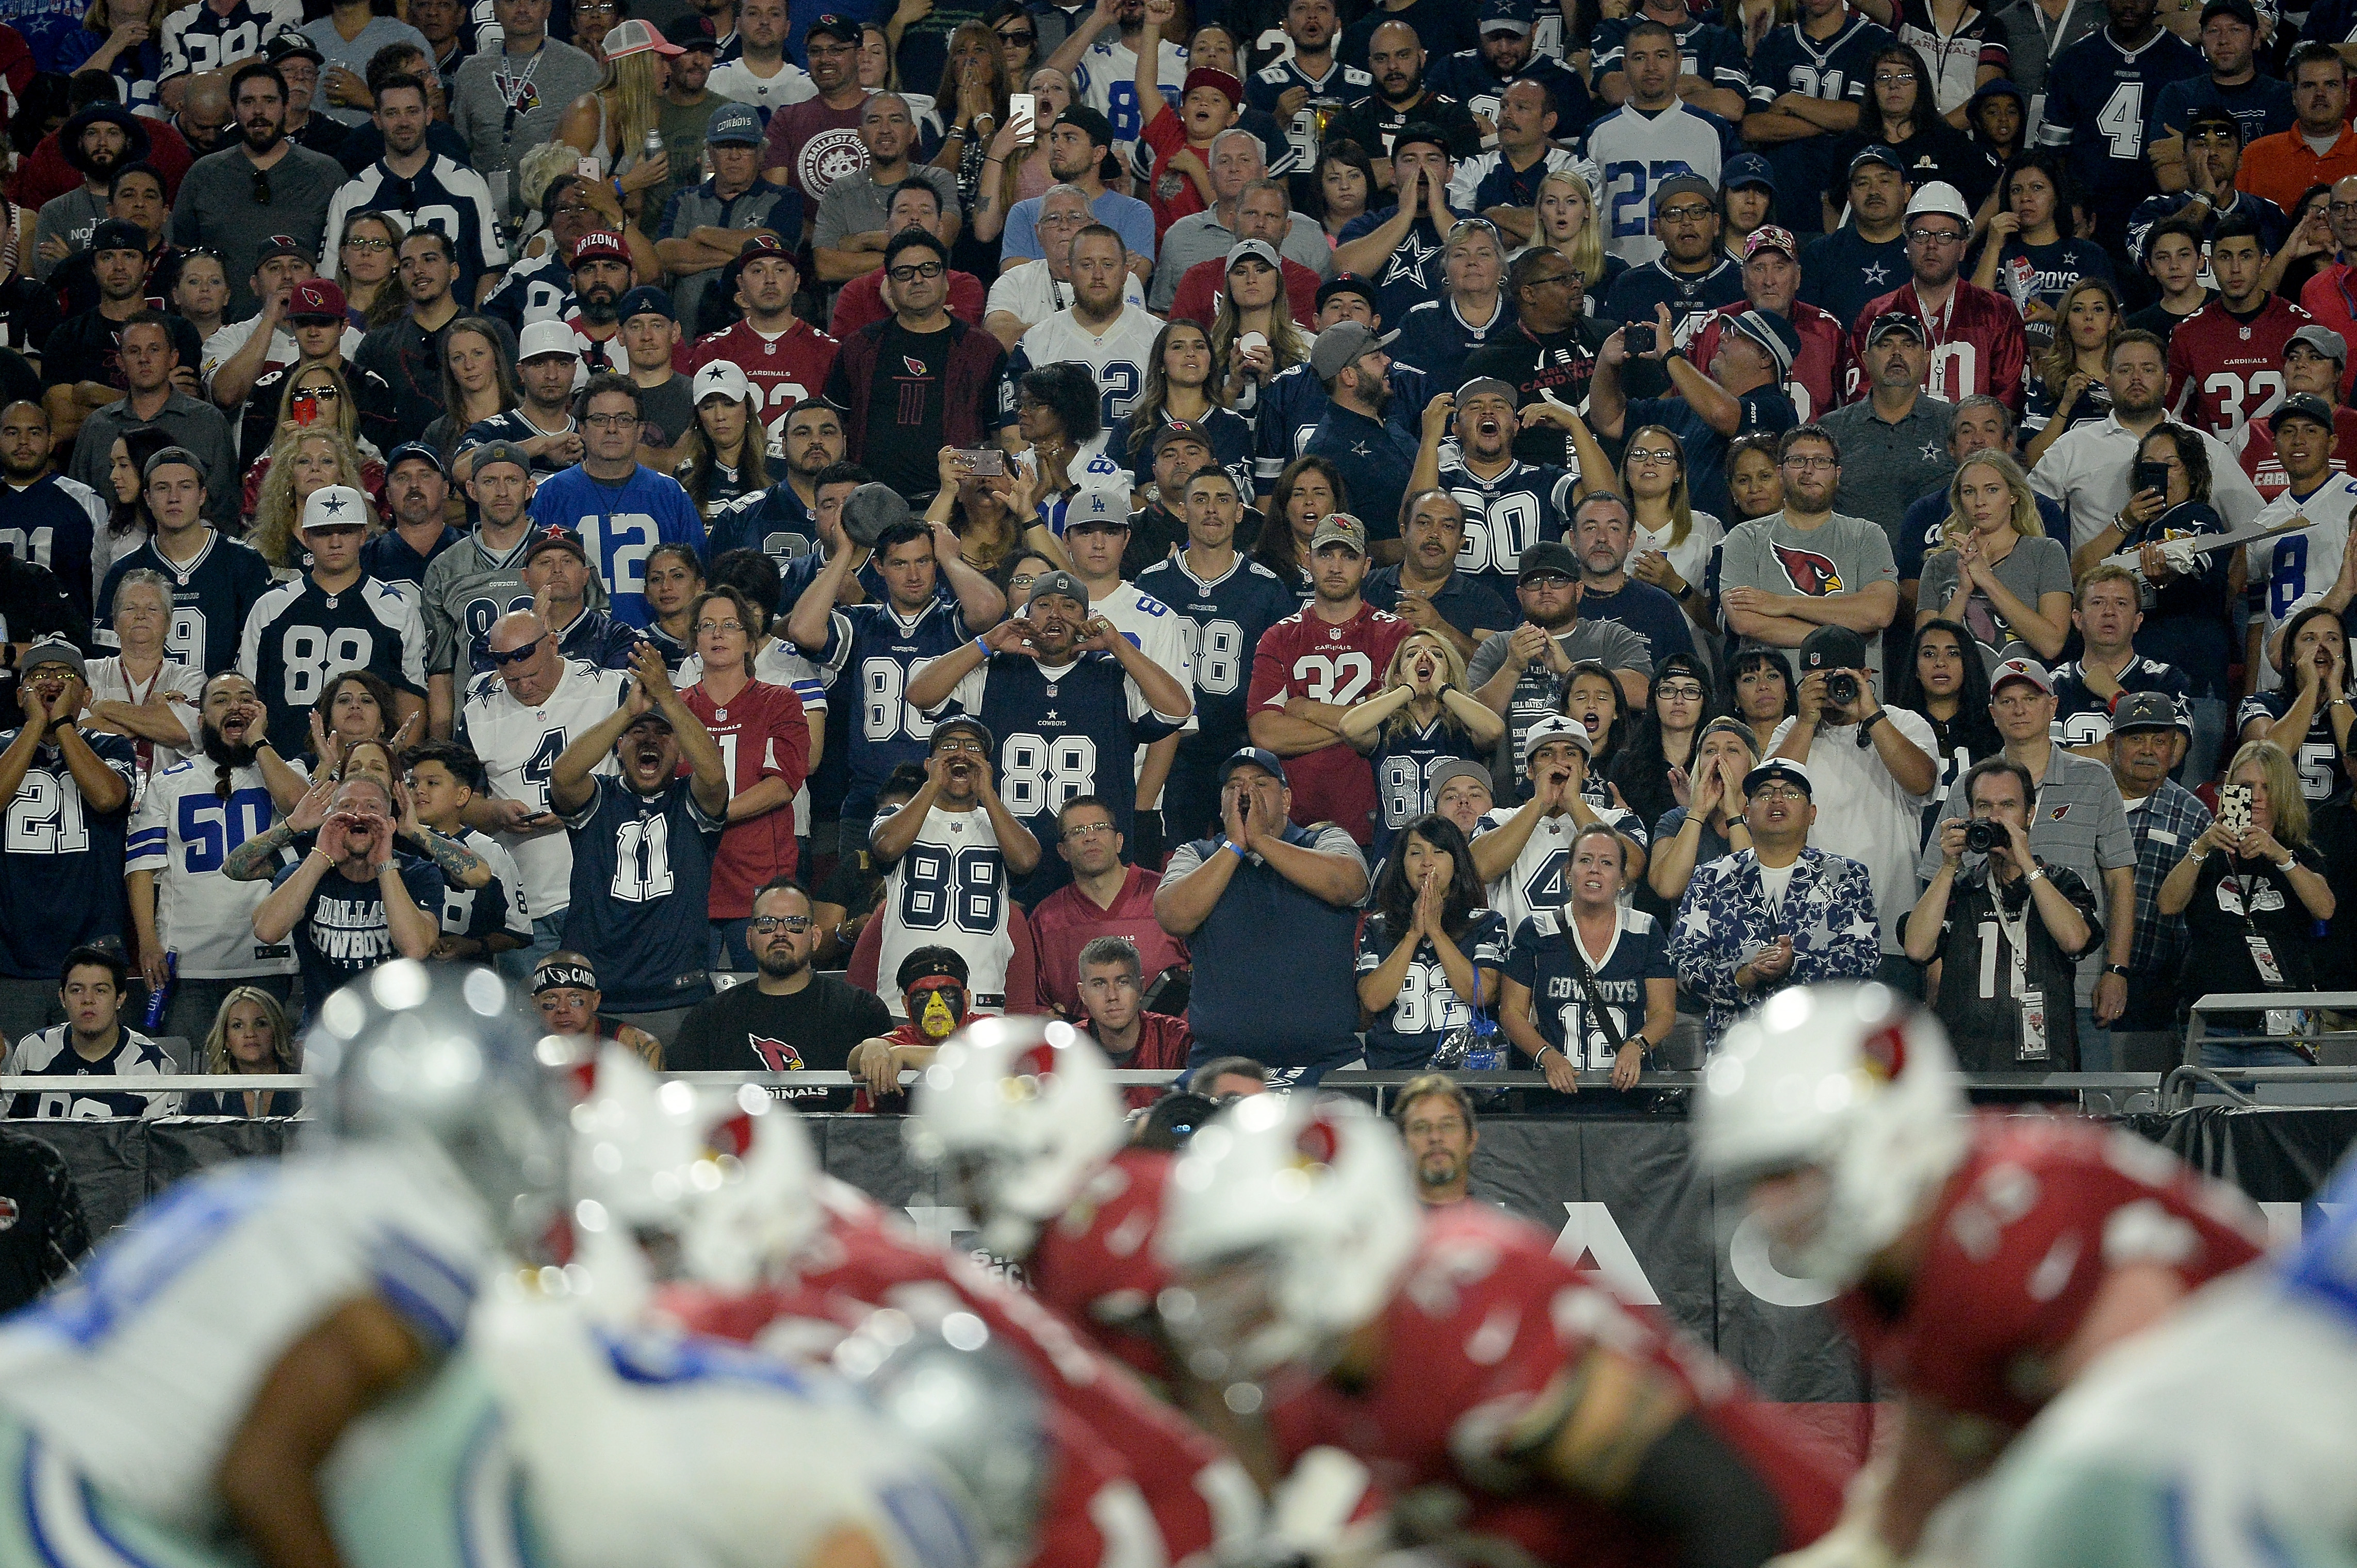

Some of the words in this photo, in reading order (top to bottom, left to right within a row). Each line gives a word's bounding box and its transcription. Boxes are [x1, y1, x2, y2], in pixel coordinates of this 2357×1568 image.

[717, 117, 751, 131] COWBOYS
[807, 135, 847, 161] BALLAST
[2097, 82, 2143, 159] 4
[576, 233, 620, 254] ARIZONA
[1996, 268, 2079, 290] CBOYS
[1063, 359, 1142, 432] 2
[1539, 358, 1595, 377] ARIONA
[2204, 371, 2286, 443] 32
[1092, 494, 1106, 513] LA
[575, 513, 660, 595] 12
[165, 606, 206, 672] 9
[283, 624, 373, 706] 88
[1293, 651, 1372, 706] 32
[707, 723, 742, 732] RDINALS
[520, 725, 569, 806] 4
[1001, 733, 1096, 818] 88
[2298, 742, 2335, 800] 5
[5, 769, 89, 854] 21
[178, 786, 274, 873] 50
[611, 812, 674, 903] 11
[899, 843, 1003, 936] 88
[1521, 848, 1570, 912] 4
[309, 927, 392, 959] COWBOY
[1392, 961, 1471, 1034] 82
[1558, 1002, 1627, 1071] 12
[765, 1086, 828, 1100] DINALS
